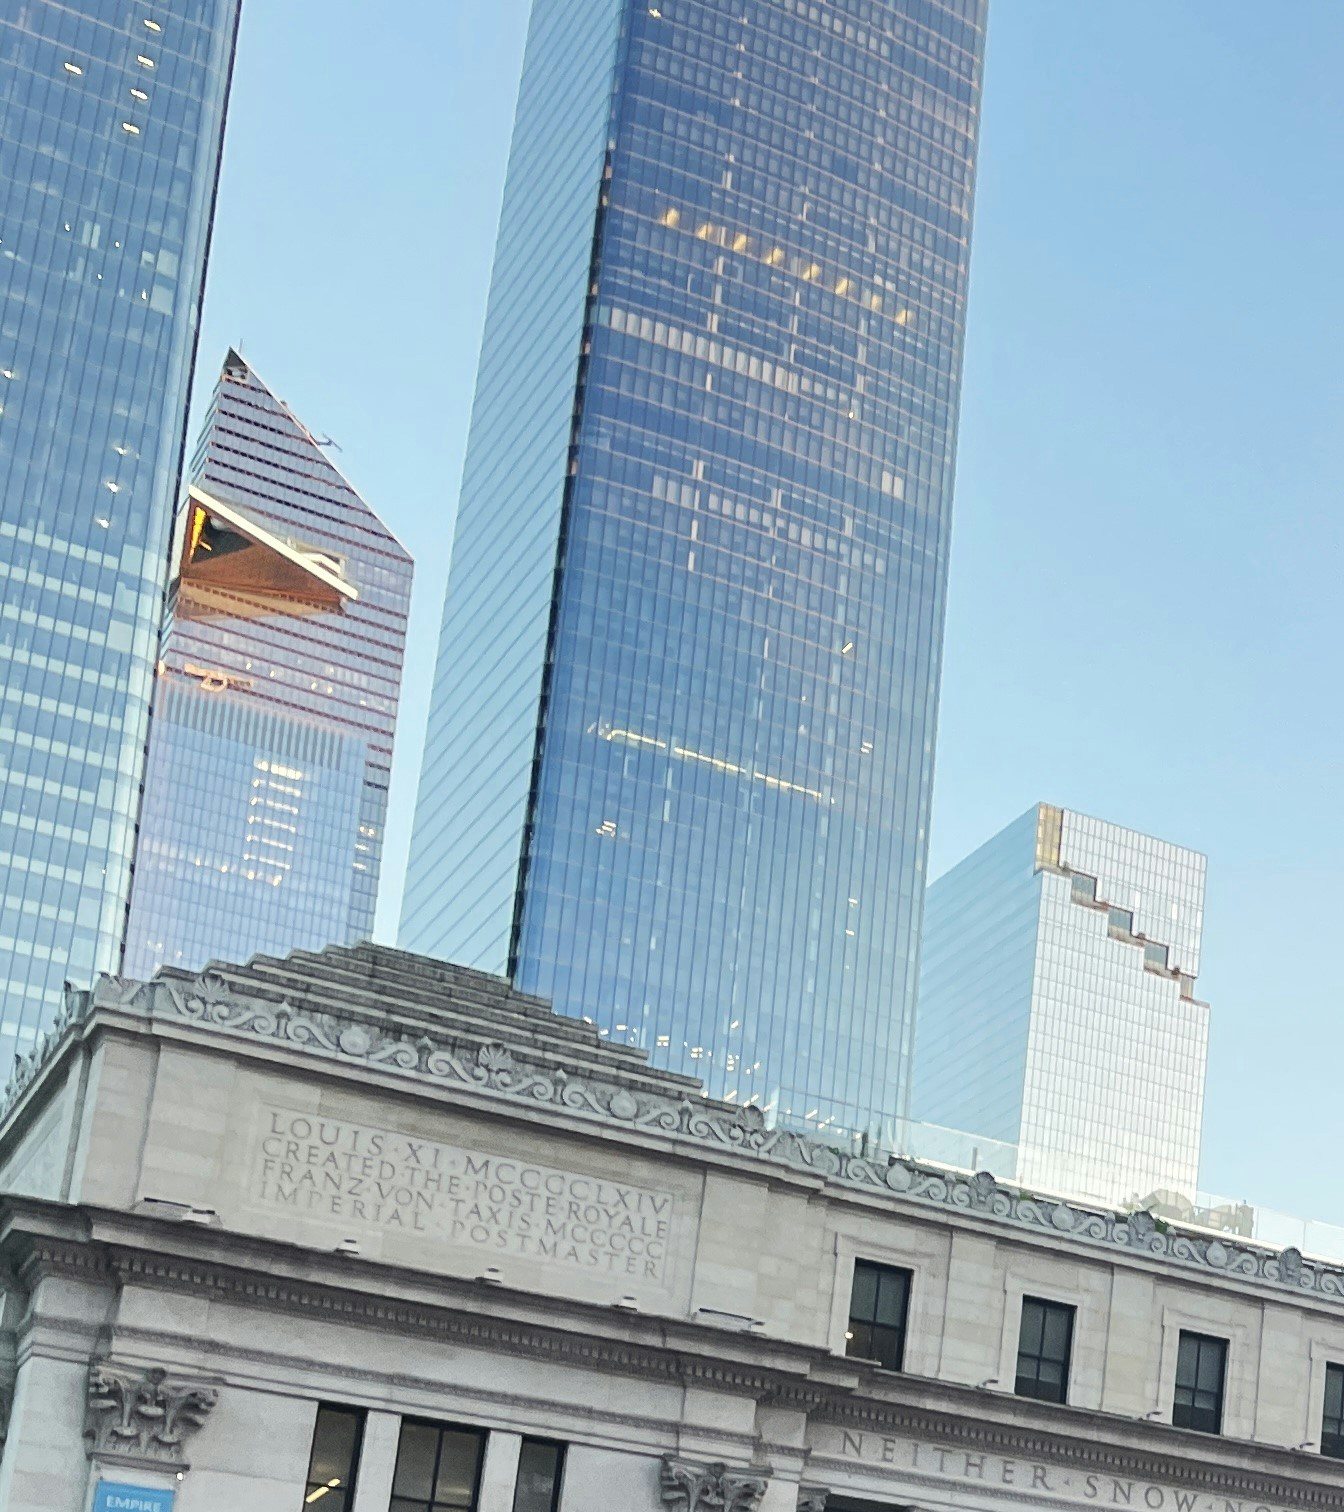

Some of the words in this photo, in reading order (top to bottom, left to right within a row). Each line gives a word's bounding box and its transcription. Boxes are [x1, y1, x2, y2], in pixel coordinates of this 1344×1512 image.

[270, 1112, 383, 1157] LOUIS
[404, 1142, 441, 1169] XI
[262, 1137, 396, 1181] CREATED
[405, 1167, 460, 1195] THE
[474, 1181, 558, 1217] POSTE
[567, 1201, 667, 1239] ROYALE
[262, 1158, 365, 1197] FRANZ
[375, 1181, 435, 1211] VON
[450, 1198, 532, 1231] TAXIS
[260, 1181, 426, 1232] IMPERIAL
[451, 1220, 658, 1280] POSTMASTER
[840, 1430, 1054, 1491] NEITHER
